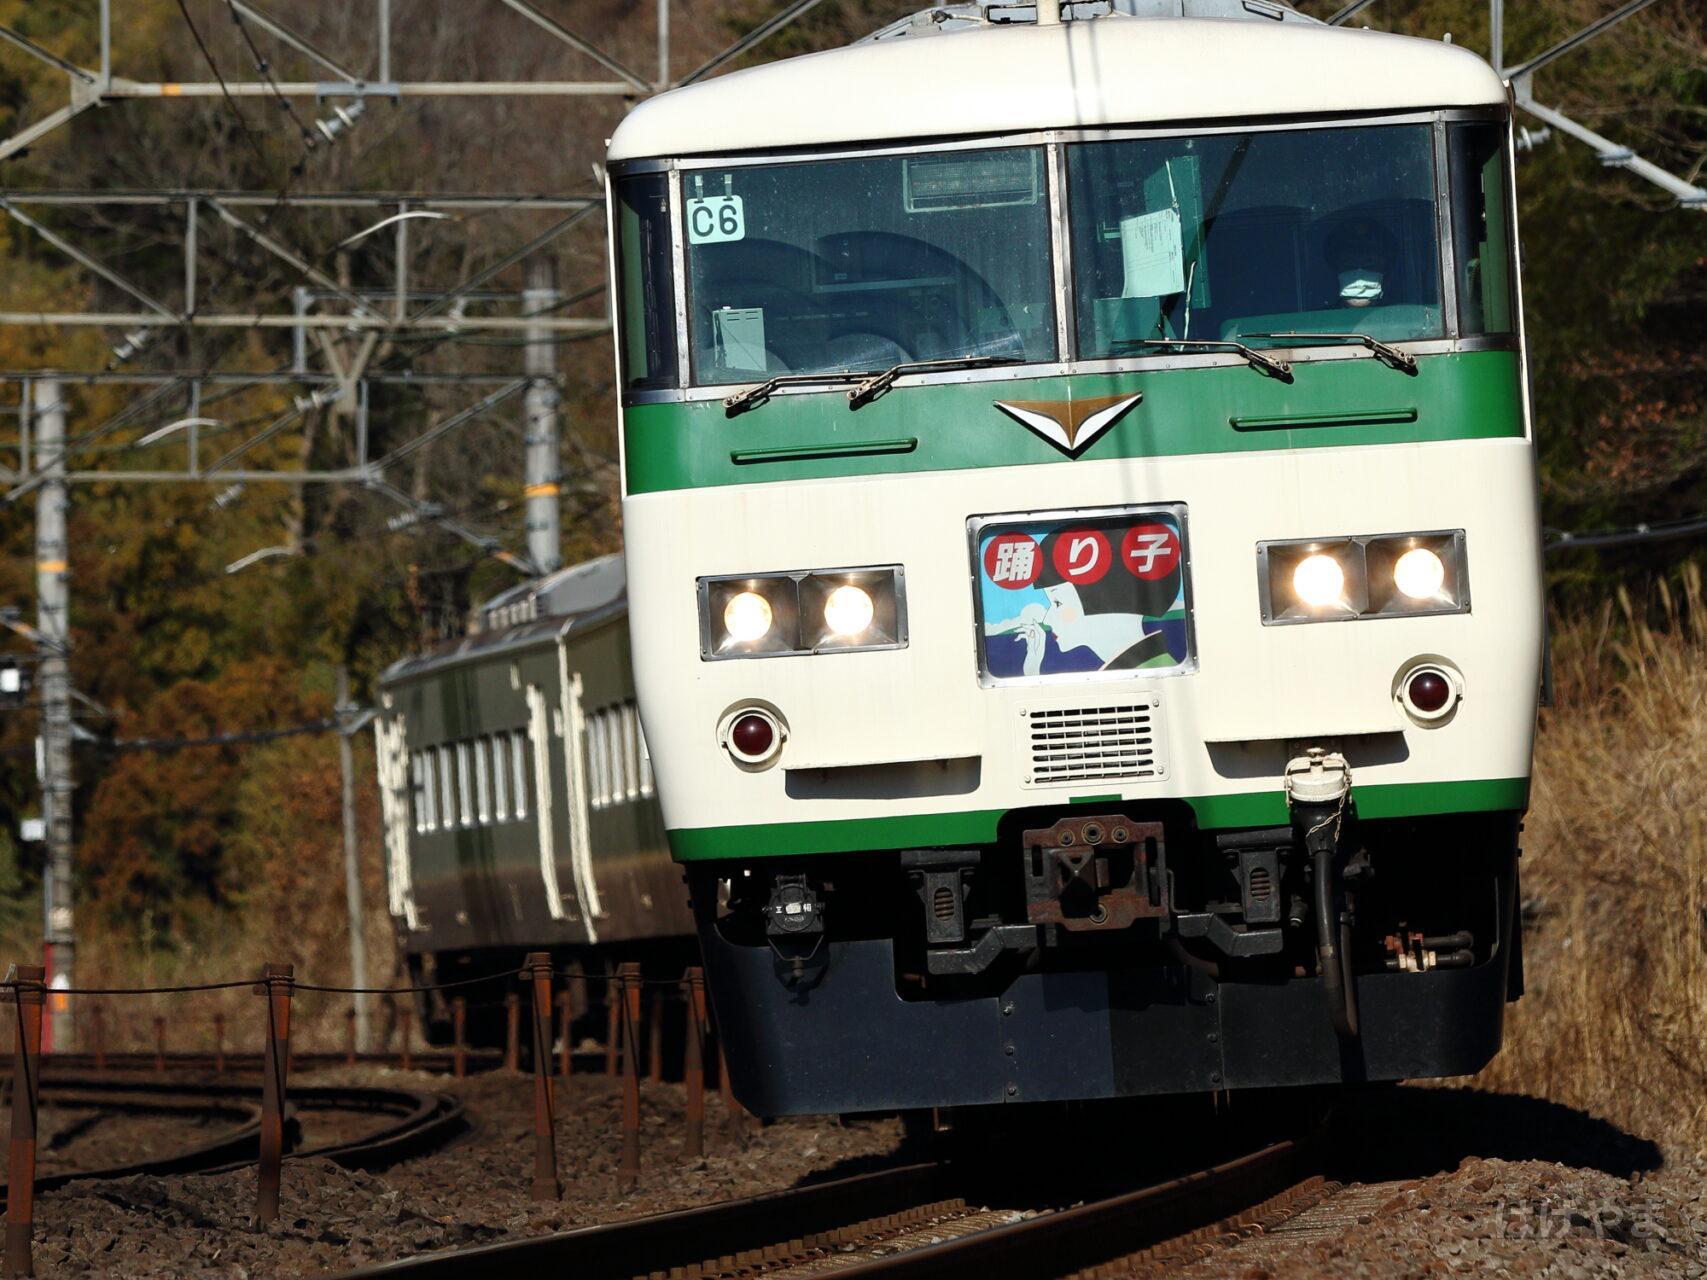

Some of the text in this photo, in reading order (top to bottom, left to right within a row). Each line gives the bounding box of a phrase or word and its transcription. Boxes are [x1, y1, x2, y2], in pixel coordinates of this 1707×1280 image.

[692, 204, 738, 237] C6
[992, 533, 1172, 582] 踊り子
